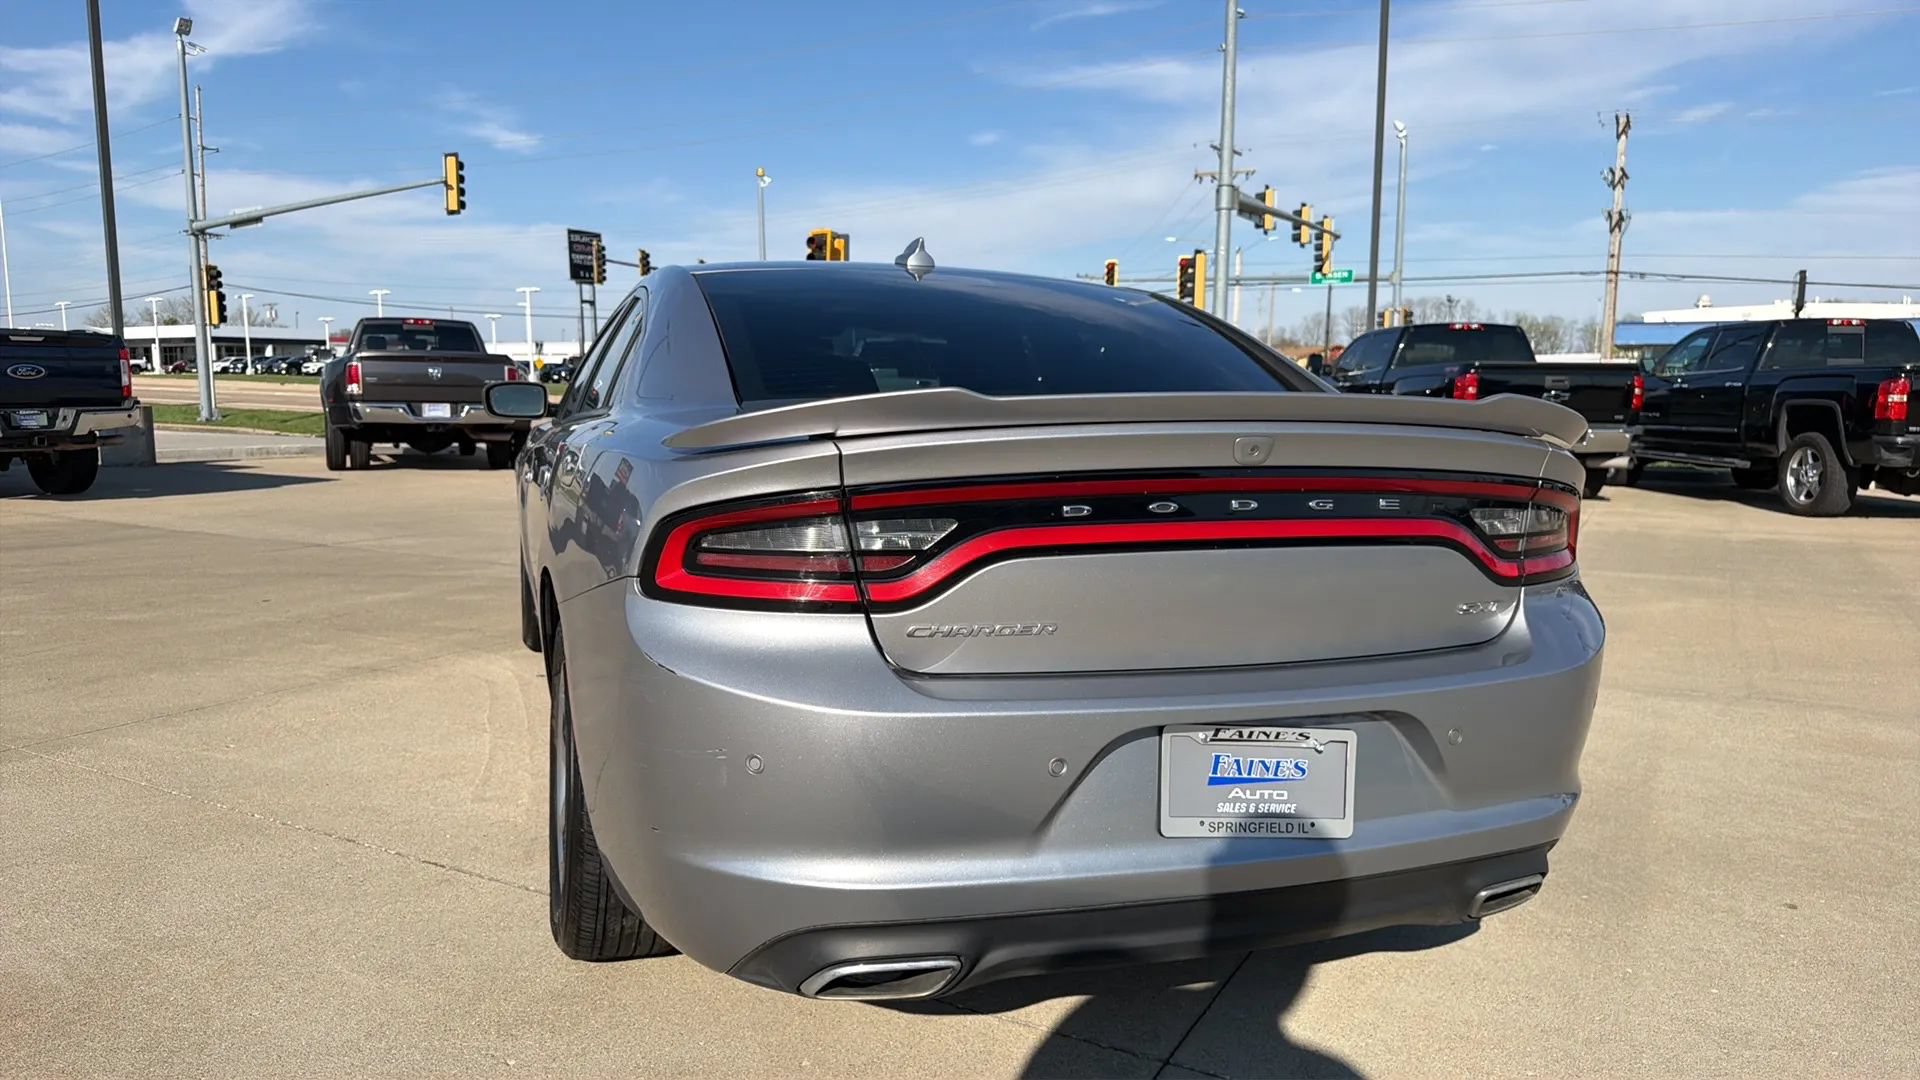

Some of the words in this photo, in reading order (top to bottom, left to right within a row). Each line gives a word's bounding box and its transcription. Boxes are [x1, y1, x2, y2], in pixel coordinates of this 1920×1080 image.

[1063, 499, 1400, 517] DODGE
[906, 623, 1058, 638] CHARGER
[1211, 728, 1311, 741] FAINE'S
[1209, 753, 1308, 779] FAINE'S
[1228, 787, 1288, 800] AUTO
[1216, 802, 1248, 813] SALES
[1257, 803, 1297, 814] SERVICE
[1208, 821, 1294, 834] SPRINGFIELD
[1298, 823, 1309, 834] IL
